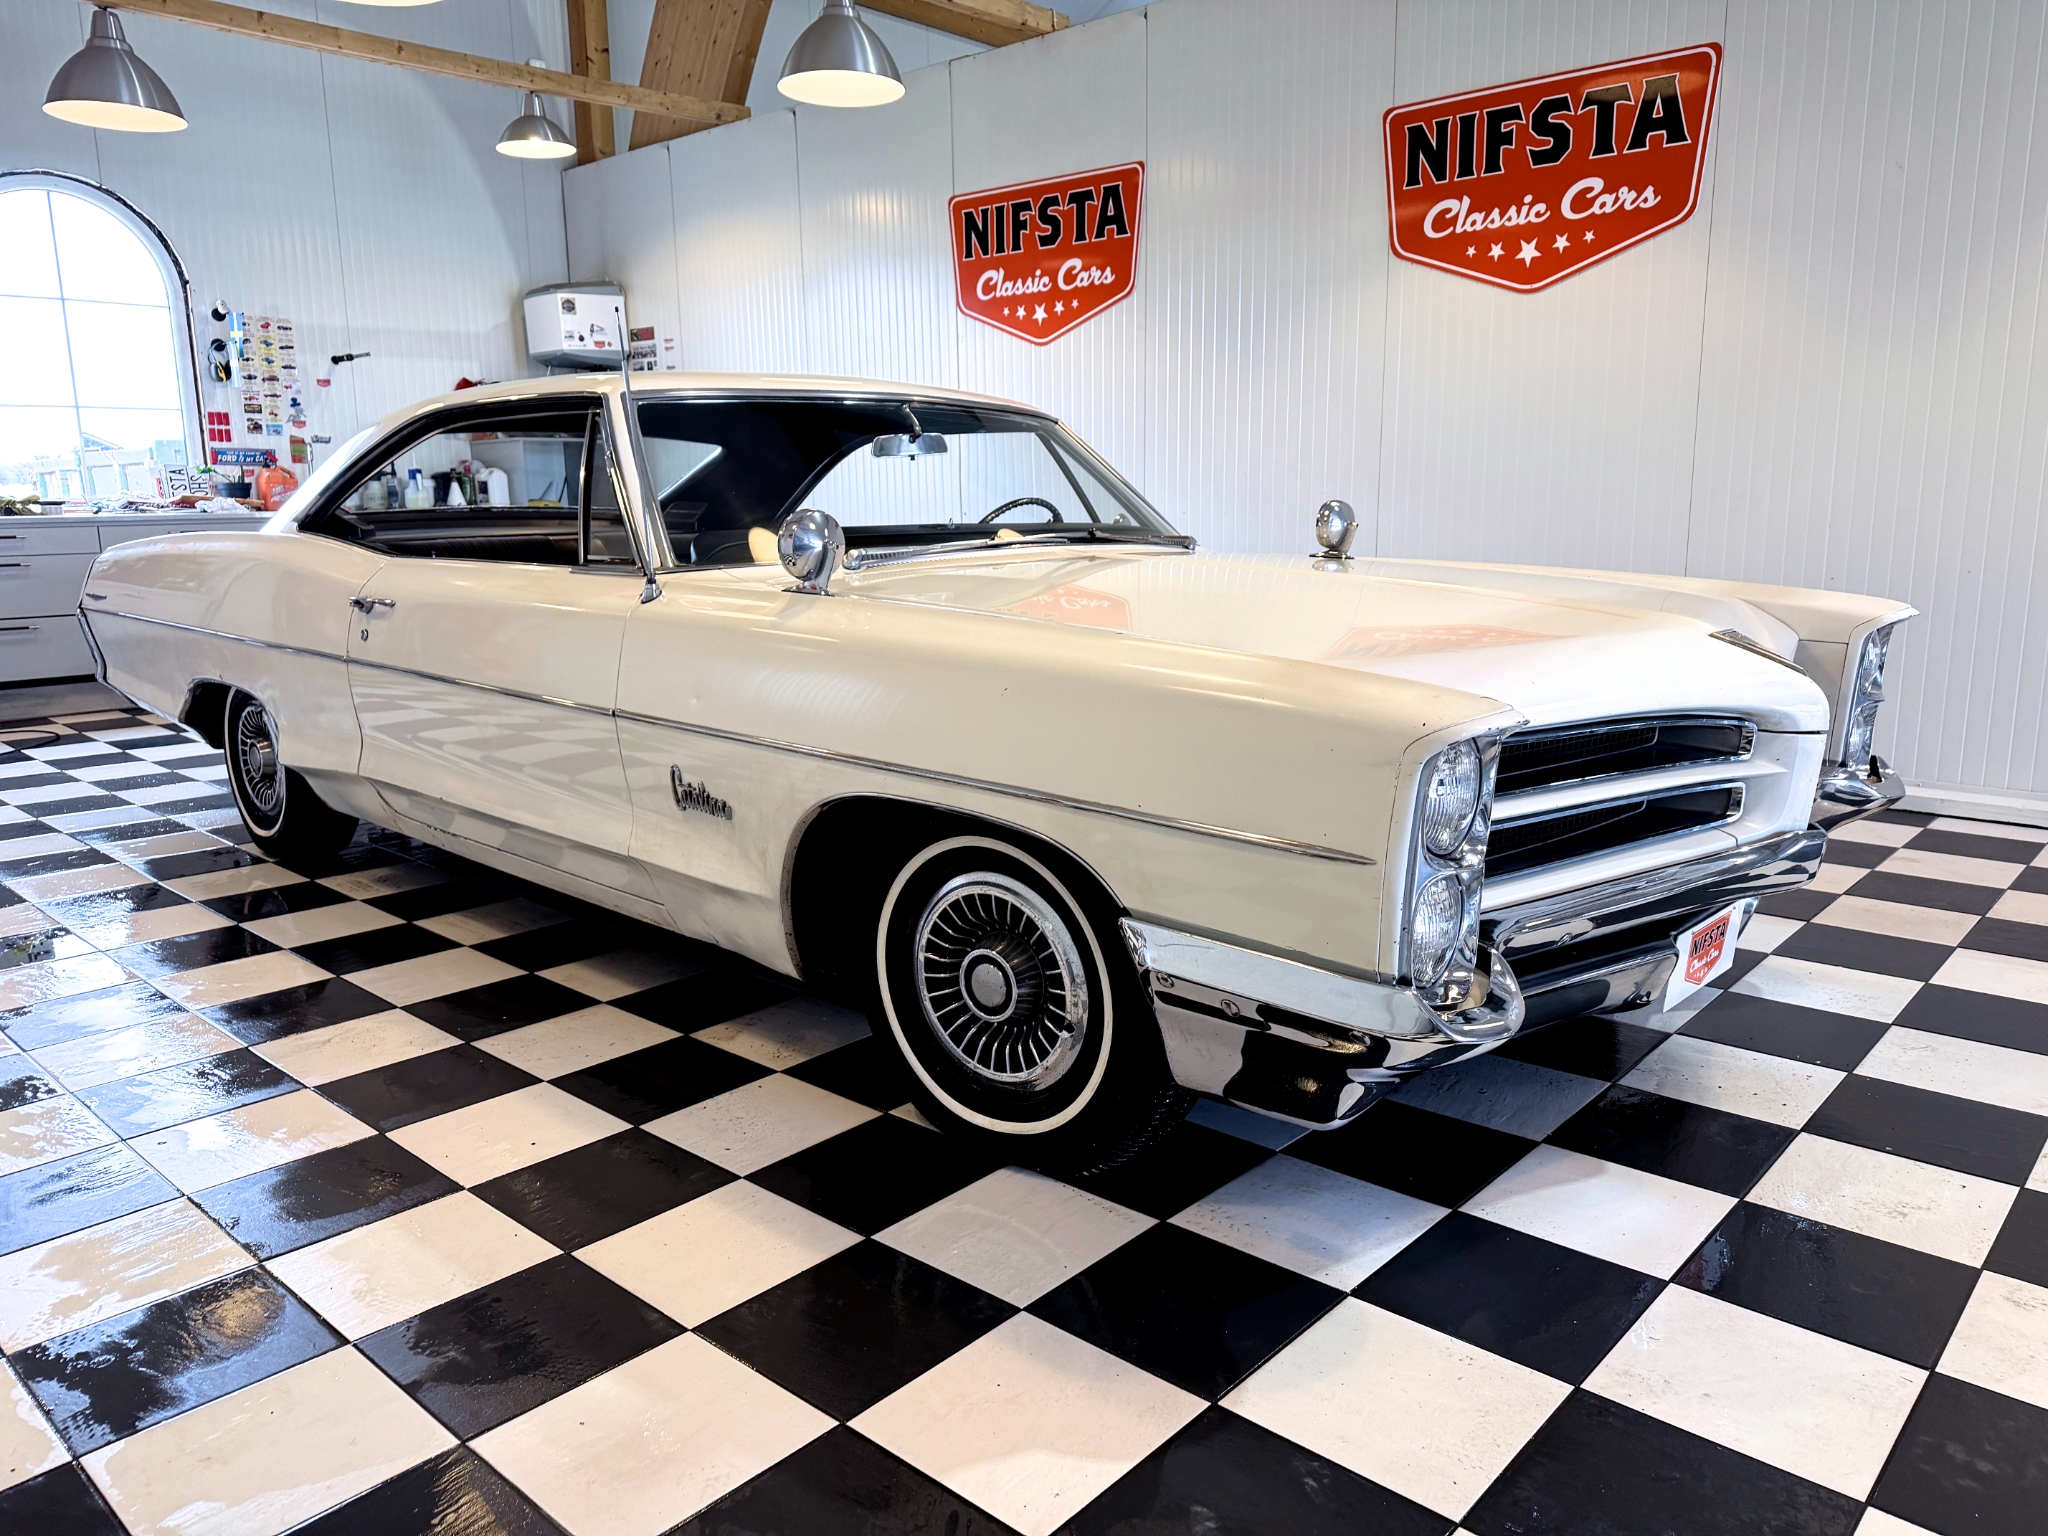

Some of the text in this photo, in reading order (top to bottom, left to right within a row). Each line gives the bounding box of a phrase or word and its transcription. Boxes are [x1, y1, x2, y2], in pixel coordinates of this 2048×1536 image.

[1402, 72, 1692, 190] NIFSTA
[961, 181, 1131, 261] NIFSTA
[1423, 176, 1662, 239] Classic Cars
[976, 258, 1115, 301] Classic Cars
[217, 454, 237, 463] FORD
[1690, 920, 1728, 960] NIFSTA
[1690, 955, 1709, 973] Classic
